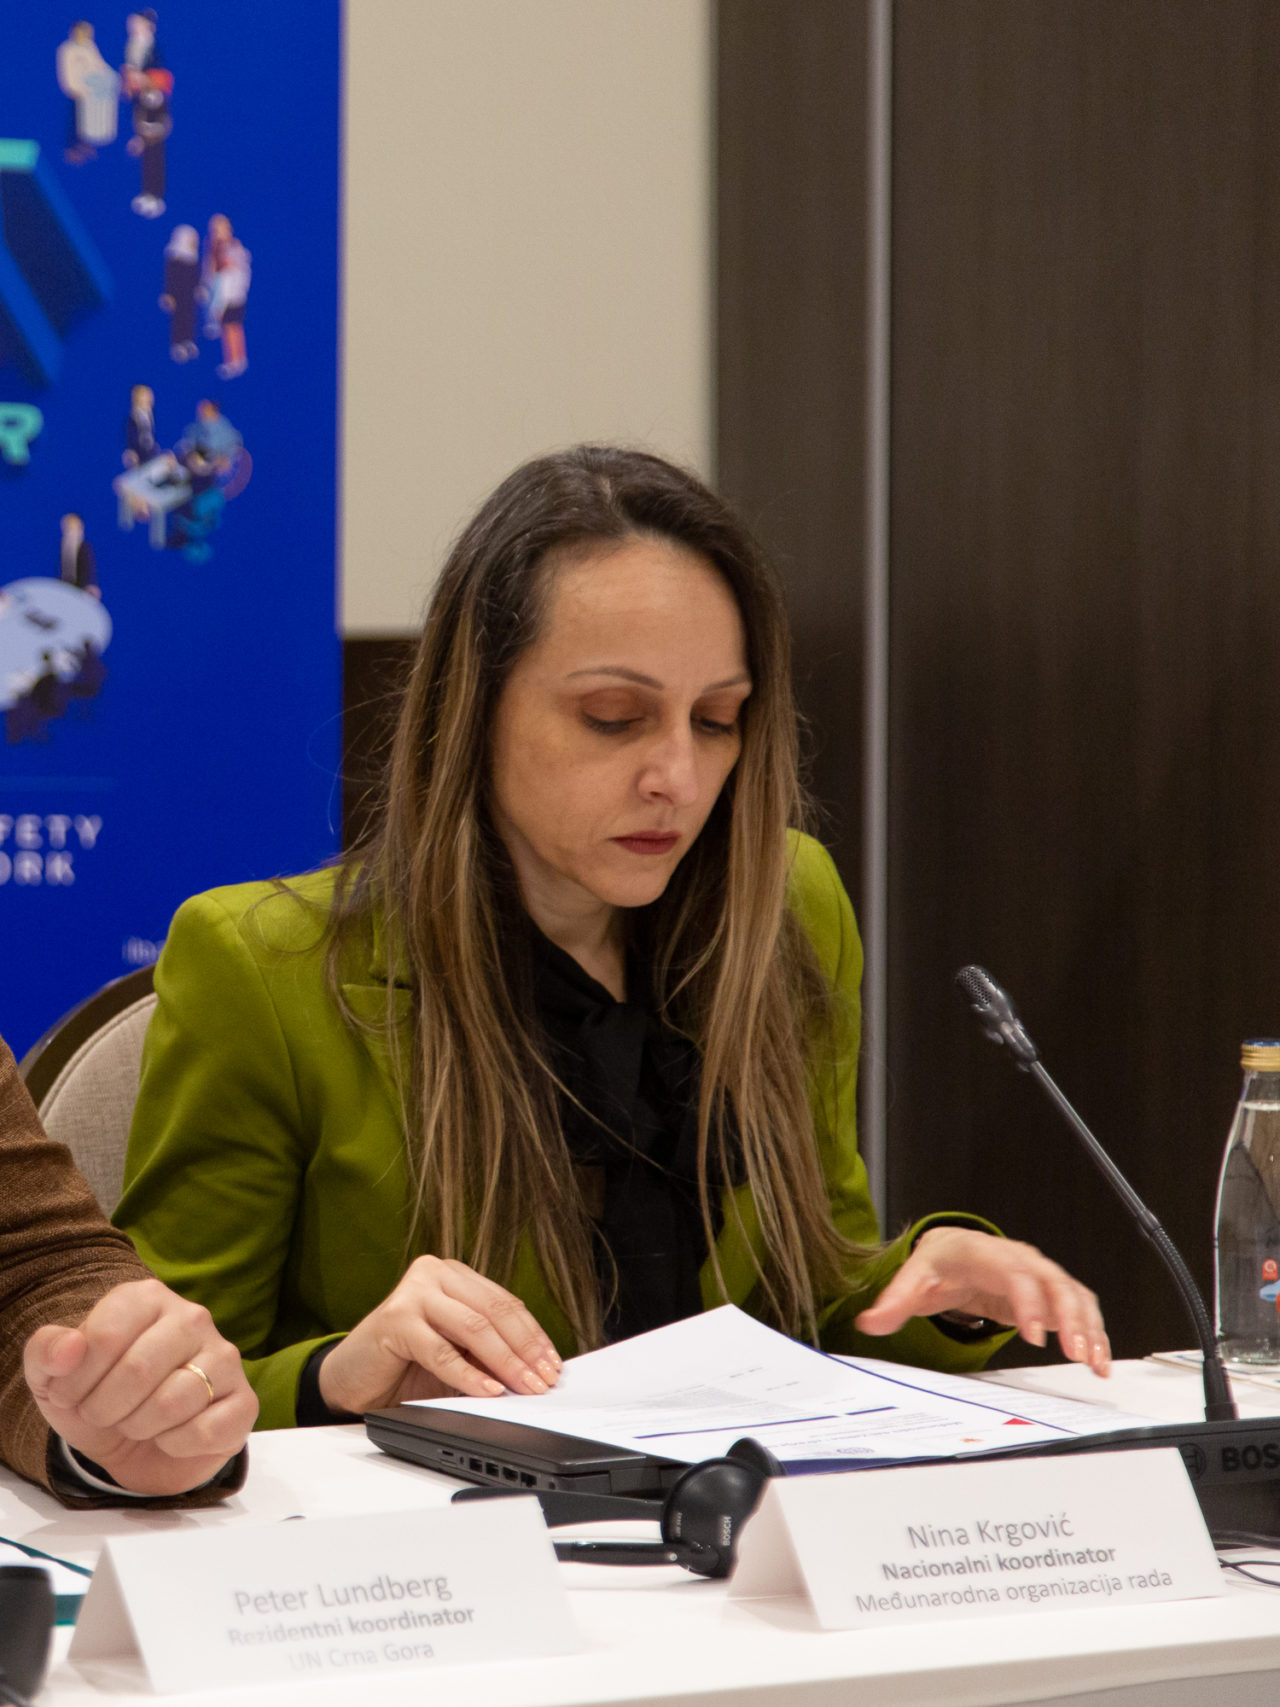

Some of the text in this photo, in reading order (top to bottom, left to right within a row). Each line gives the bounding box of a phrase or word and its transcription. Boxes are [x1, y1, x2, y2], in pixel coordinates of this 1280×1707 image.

[722, 1515, 732, 1546] BOSCH
[907, 1513, 1074, 1550] Nina Krgović
[883, 1547, 1117, 1582] Nacionalni koordinator
[234, 1575, 453, 1616] Peter Lundberg
[855, 1569, 1173, 1614] Međunarodna organizacija rada
[227, 1606, 475, 1647] Rezidentni koordinator
[328, 1647, 379, 1668] Crna
[385, 1643, 435, 1664] Gora
